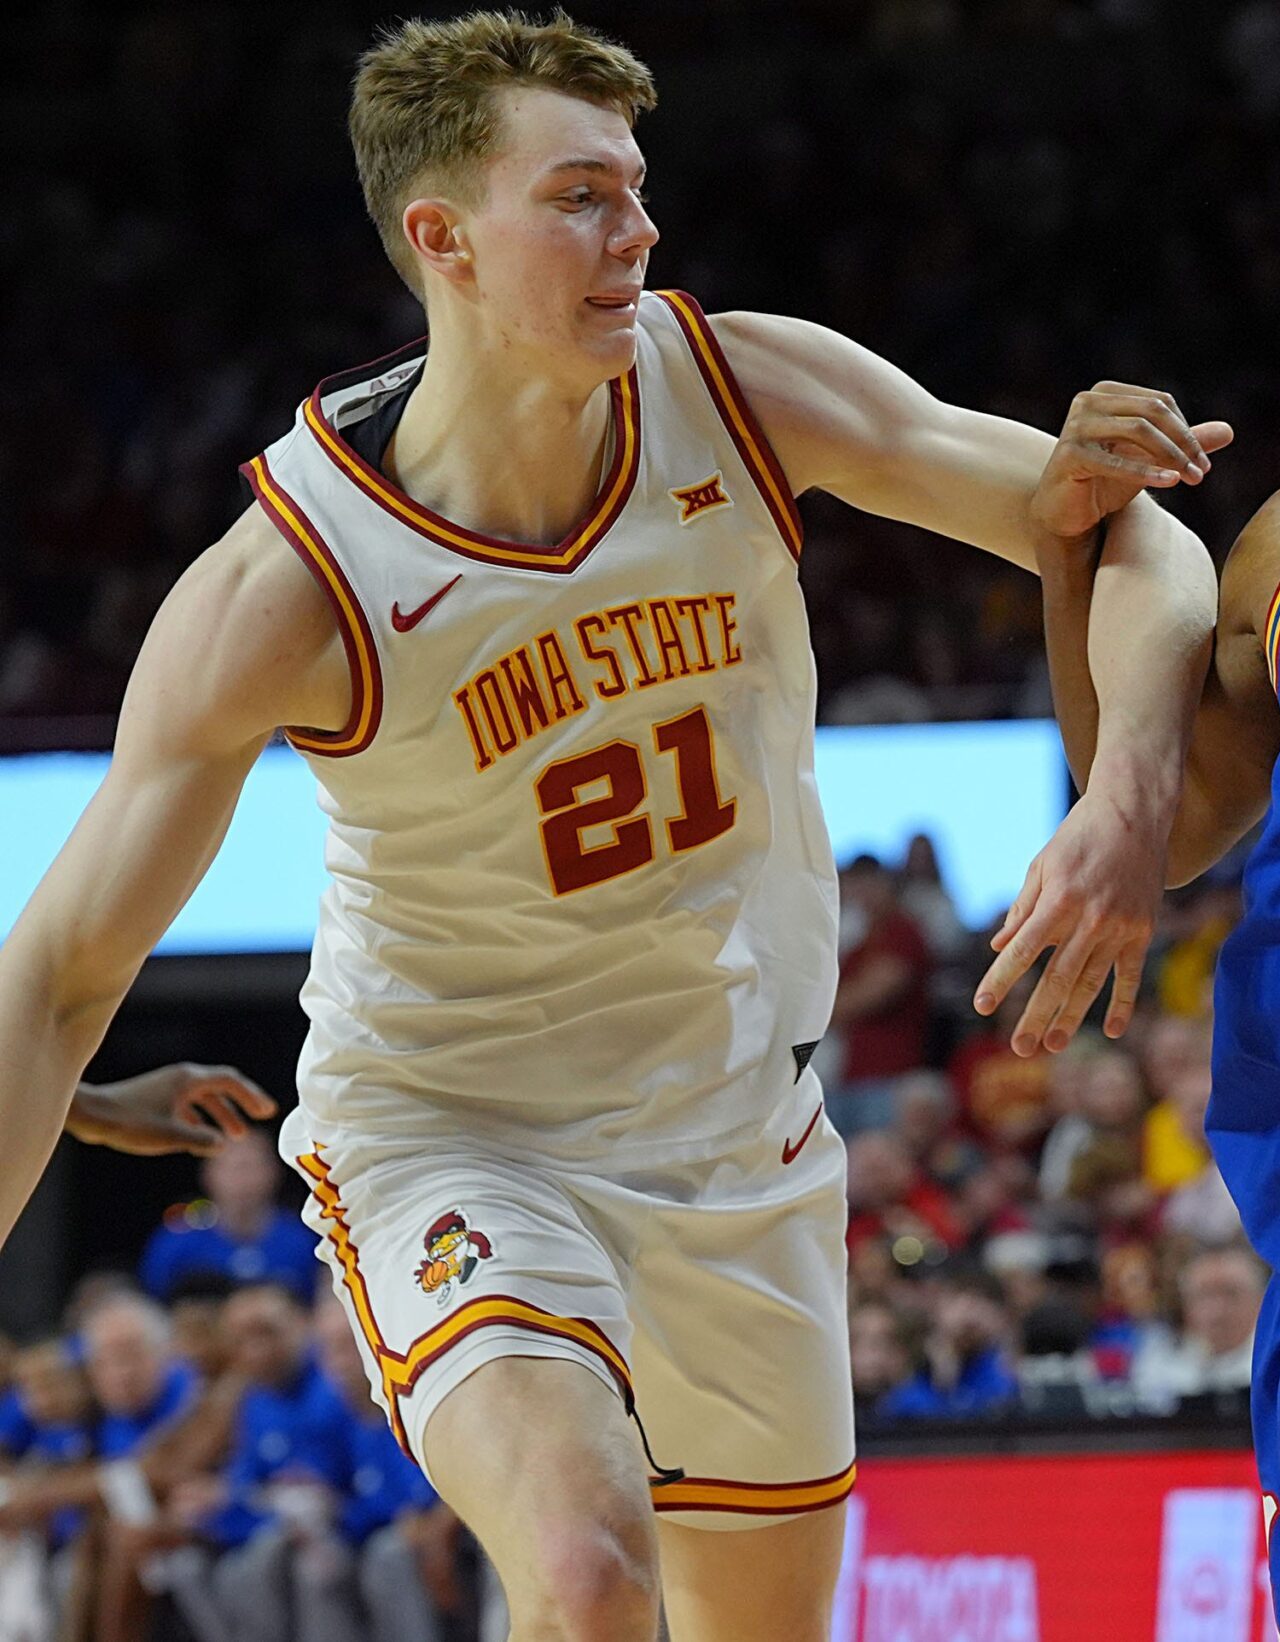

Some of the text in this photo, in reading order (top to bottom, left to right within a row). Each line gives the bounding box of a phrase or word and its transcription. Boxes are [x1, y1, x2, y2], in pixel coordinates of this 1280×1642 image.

[672, 474, 730, 521] XII
[453, 592, 742, 773] IOWA STATE
[533, 703, 738, 897] 21
